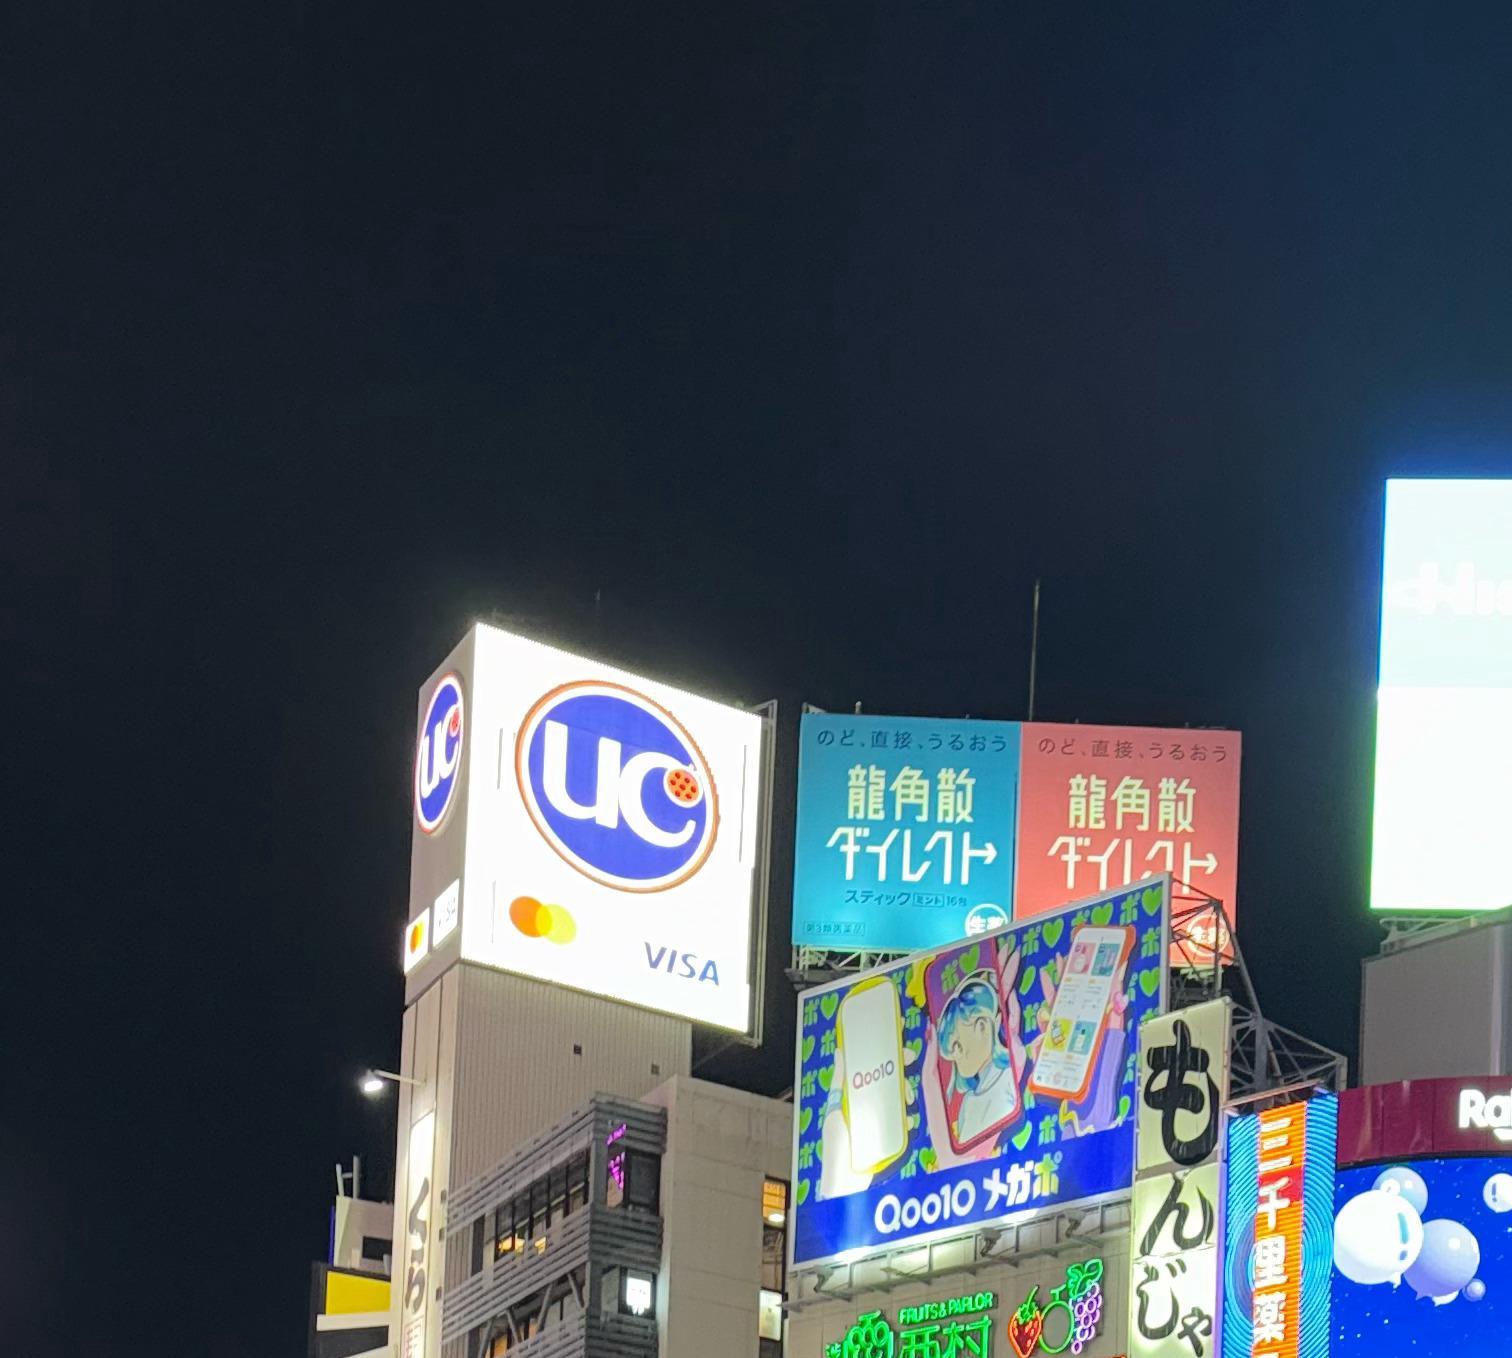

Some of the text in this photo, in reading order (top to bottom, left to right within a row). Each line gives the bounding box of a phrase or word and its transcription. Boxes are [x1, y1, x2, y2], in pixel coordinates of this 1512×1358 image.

[817, 730, 1007, 753] のど、直接、うるおう
[1039, 738, 1227, 763] のど、直接、うるおう
[847, 764, 976, 824] 龍角散
[1068, 773, 1197, 834] 龍角散
[826, 827, 998, 885] ダイレクト
[846, 889, 911, 907] スティック
[644, 941, 720, 986] VISA
[853, 1060, 895, 1090] Qoo10
[874, 1152, 1060, 1235] Qoo10 メガポ
[1137, 1018, 1222, 1358] もんじゃ
